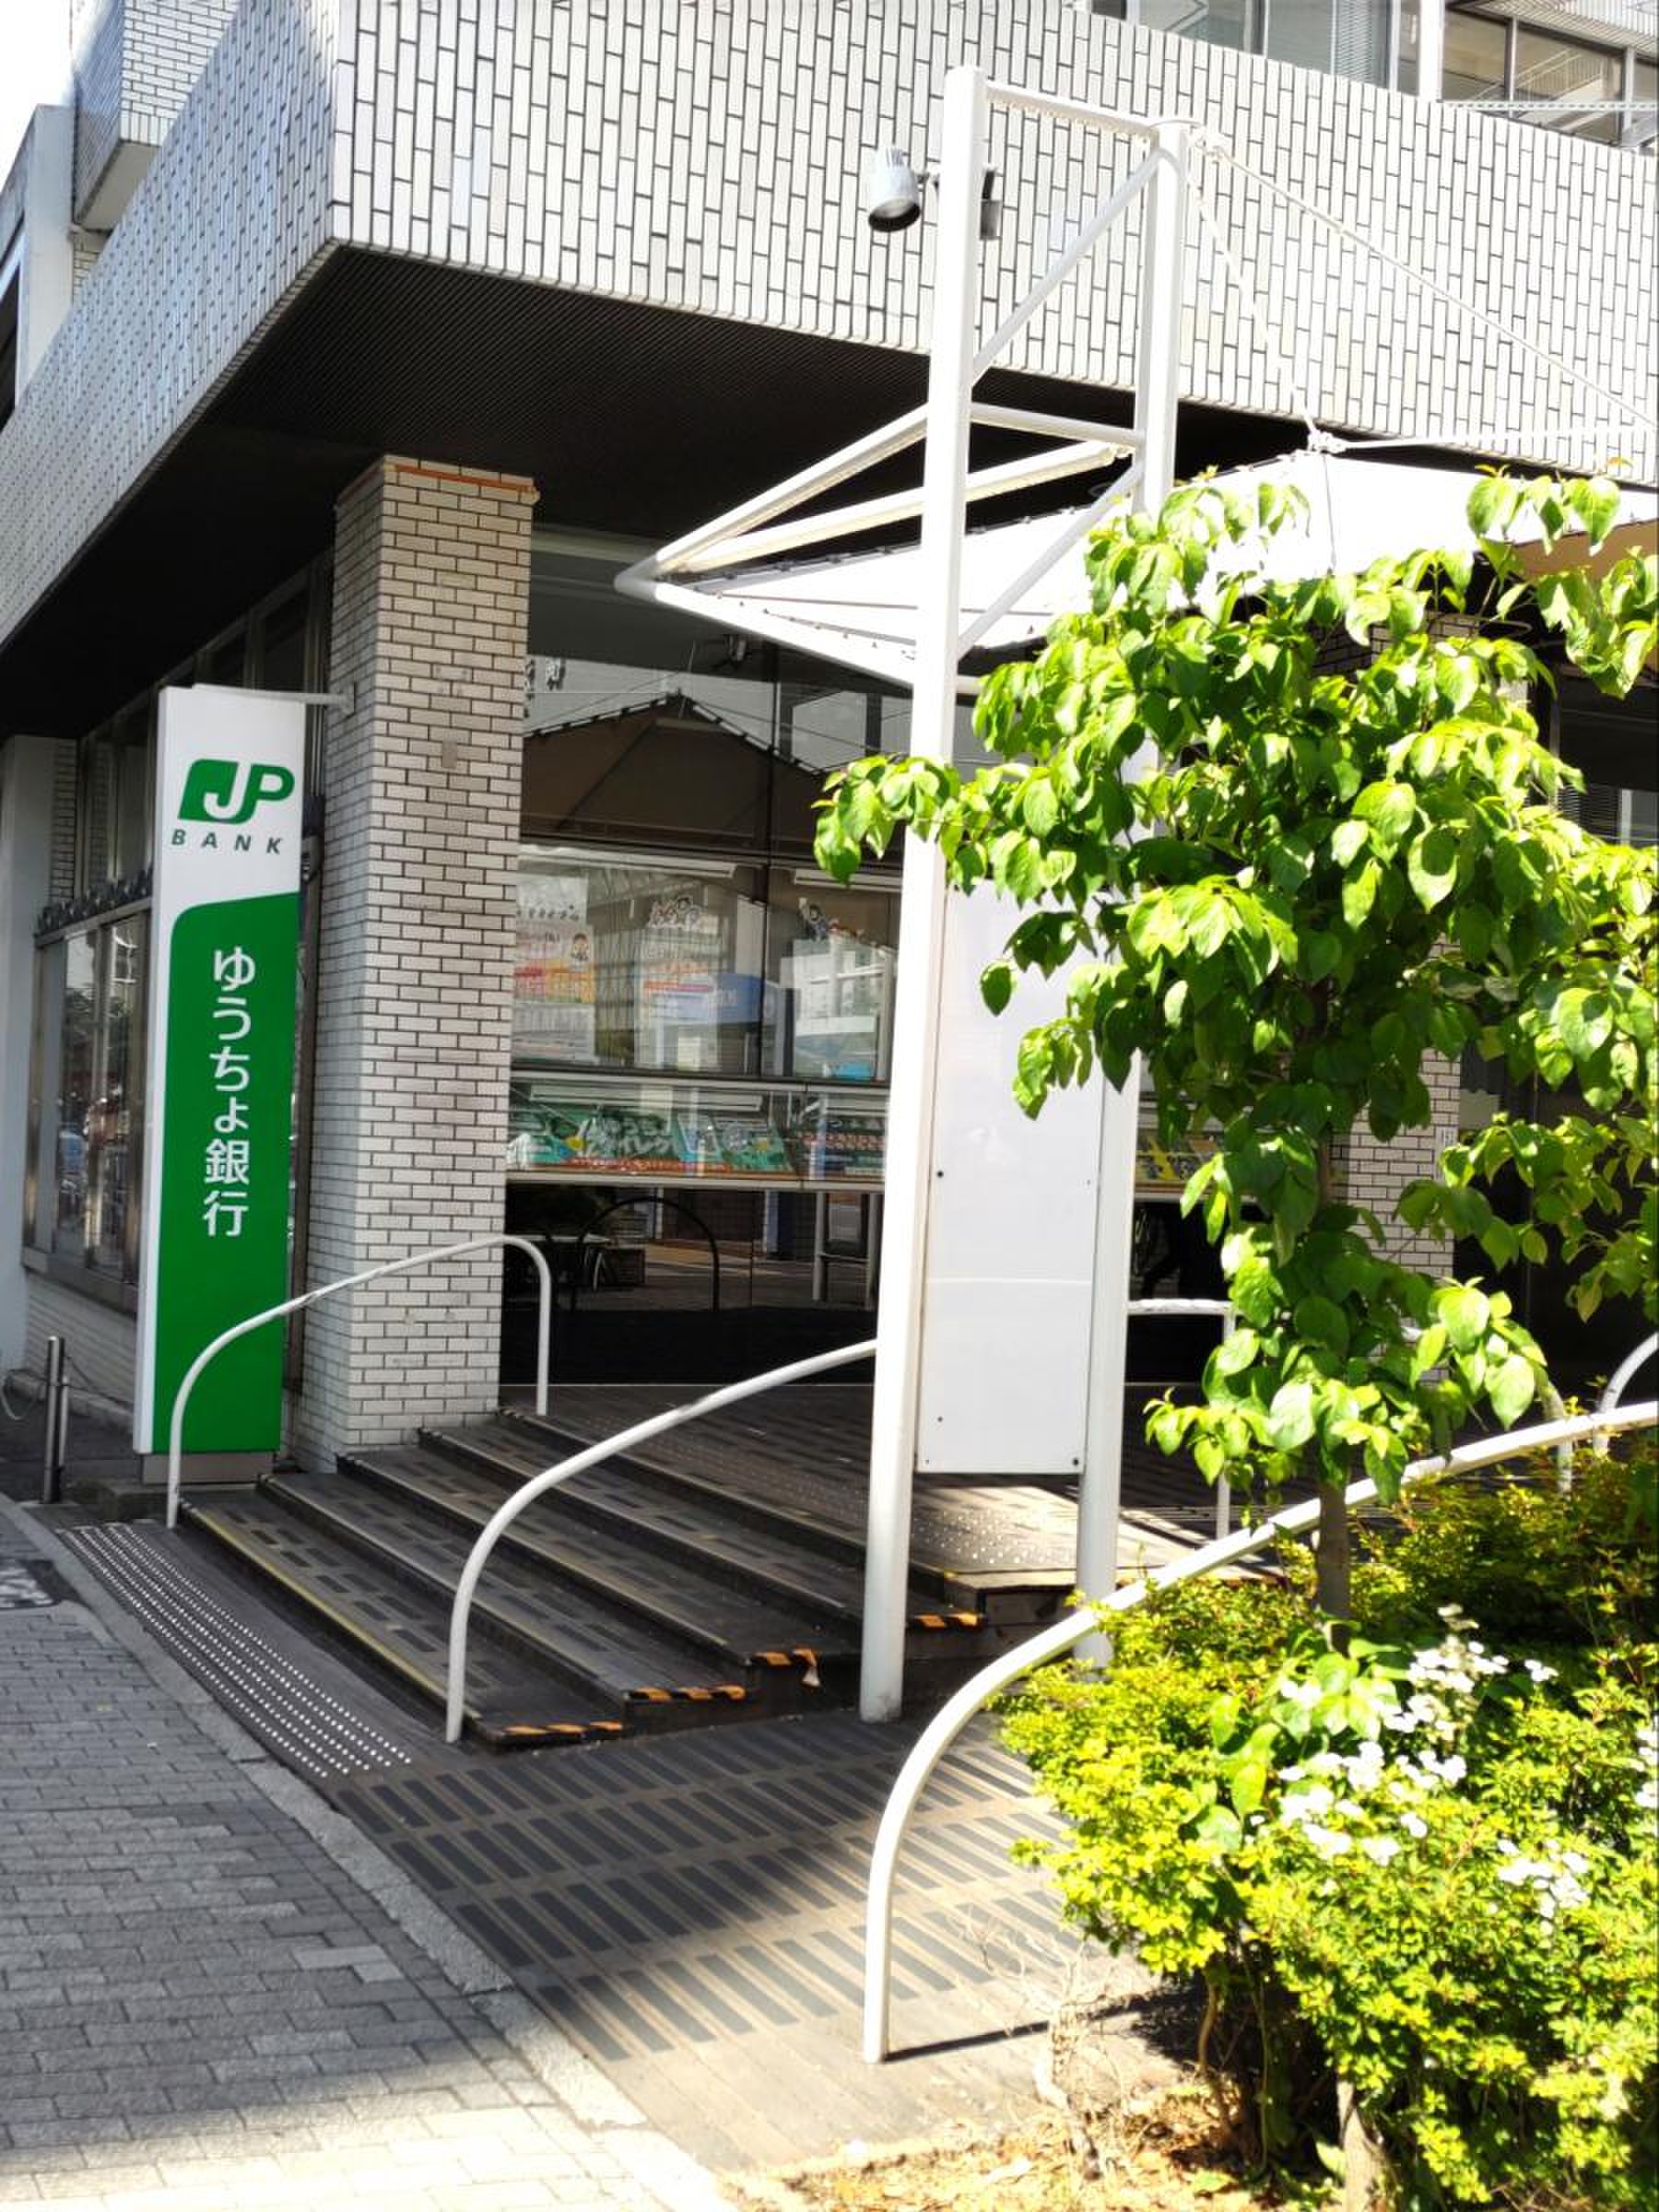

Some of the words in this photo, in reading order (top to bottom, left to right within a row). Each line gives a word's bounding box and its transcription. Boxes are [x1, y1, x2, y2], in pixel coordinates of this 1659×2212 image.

[178, 759, 295, 825] JP
[171, 830, 282, 854] BANK
[203, 946, 255, 1236] ゆうちょ銀行
